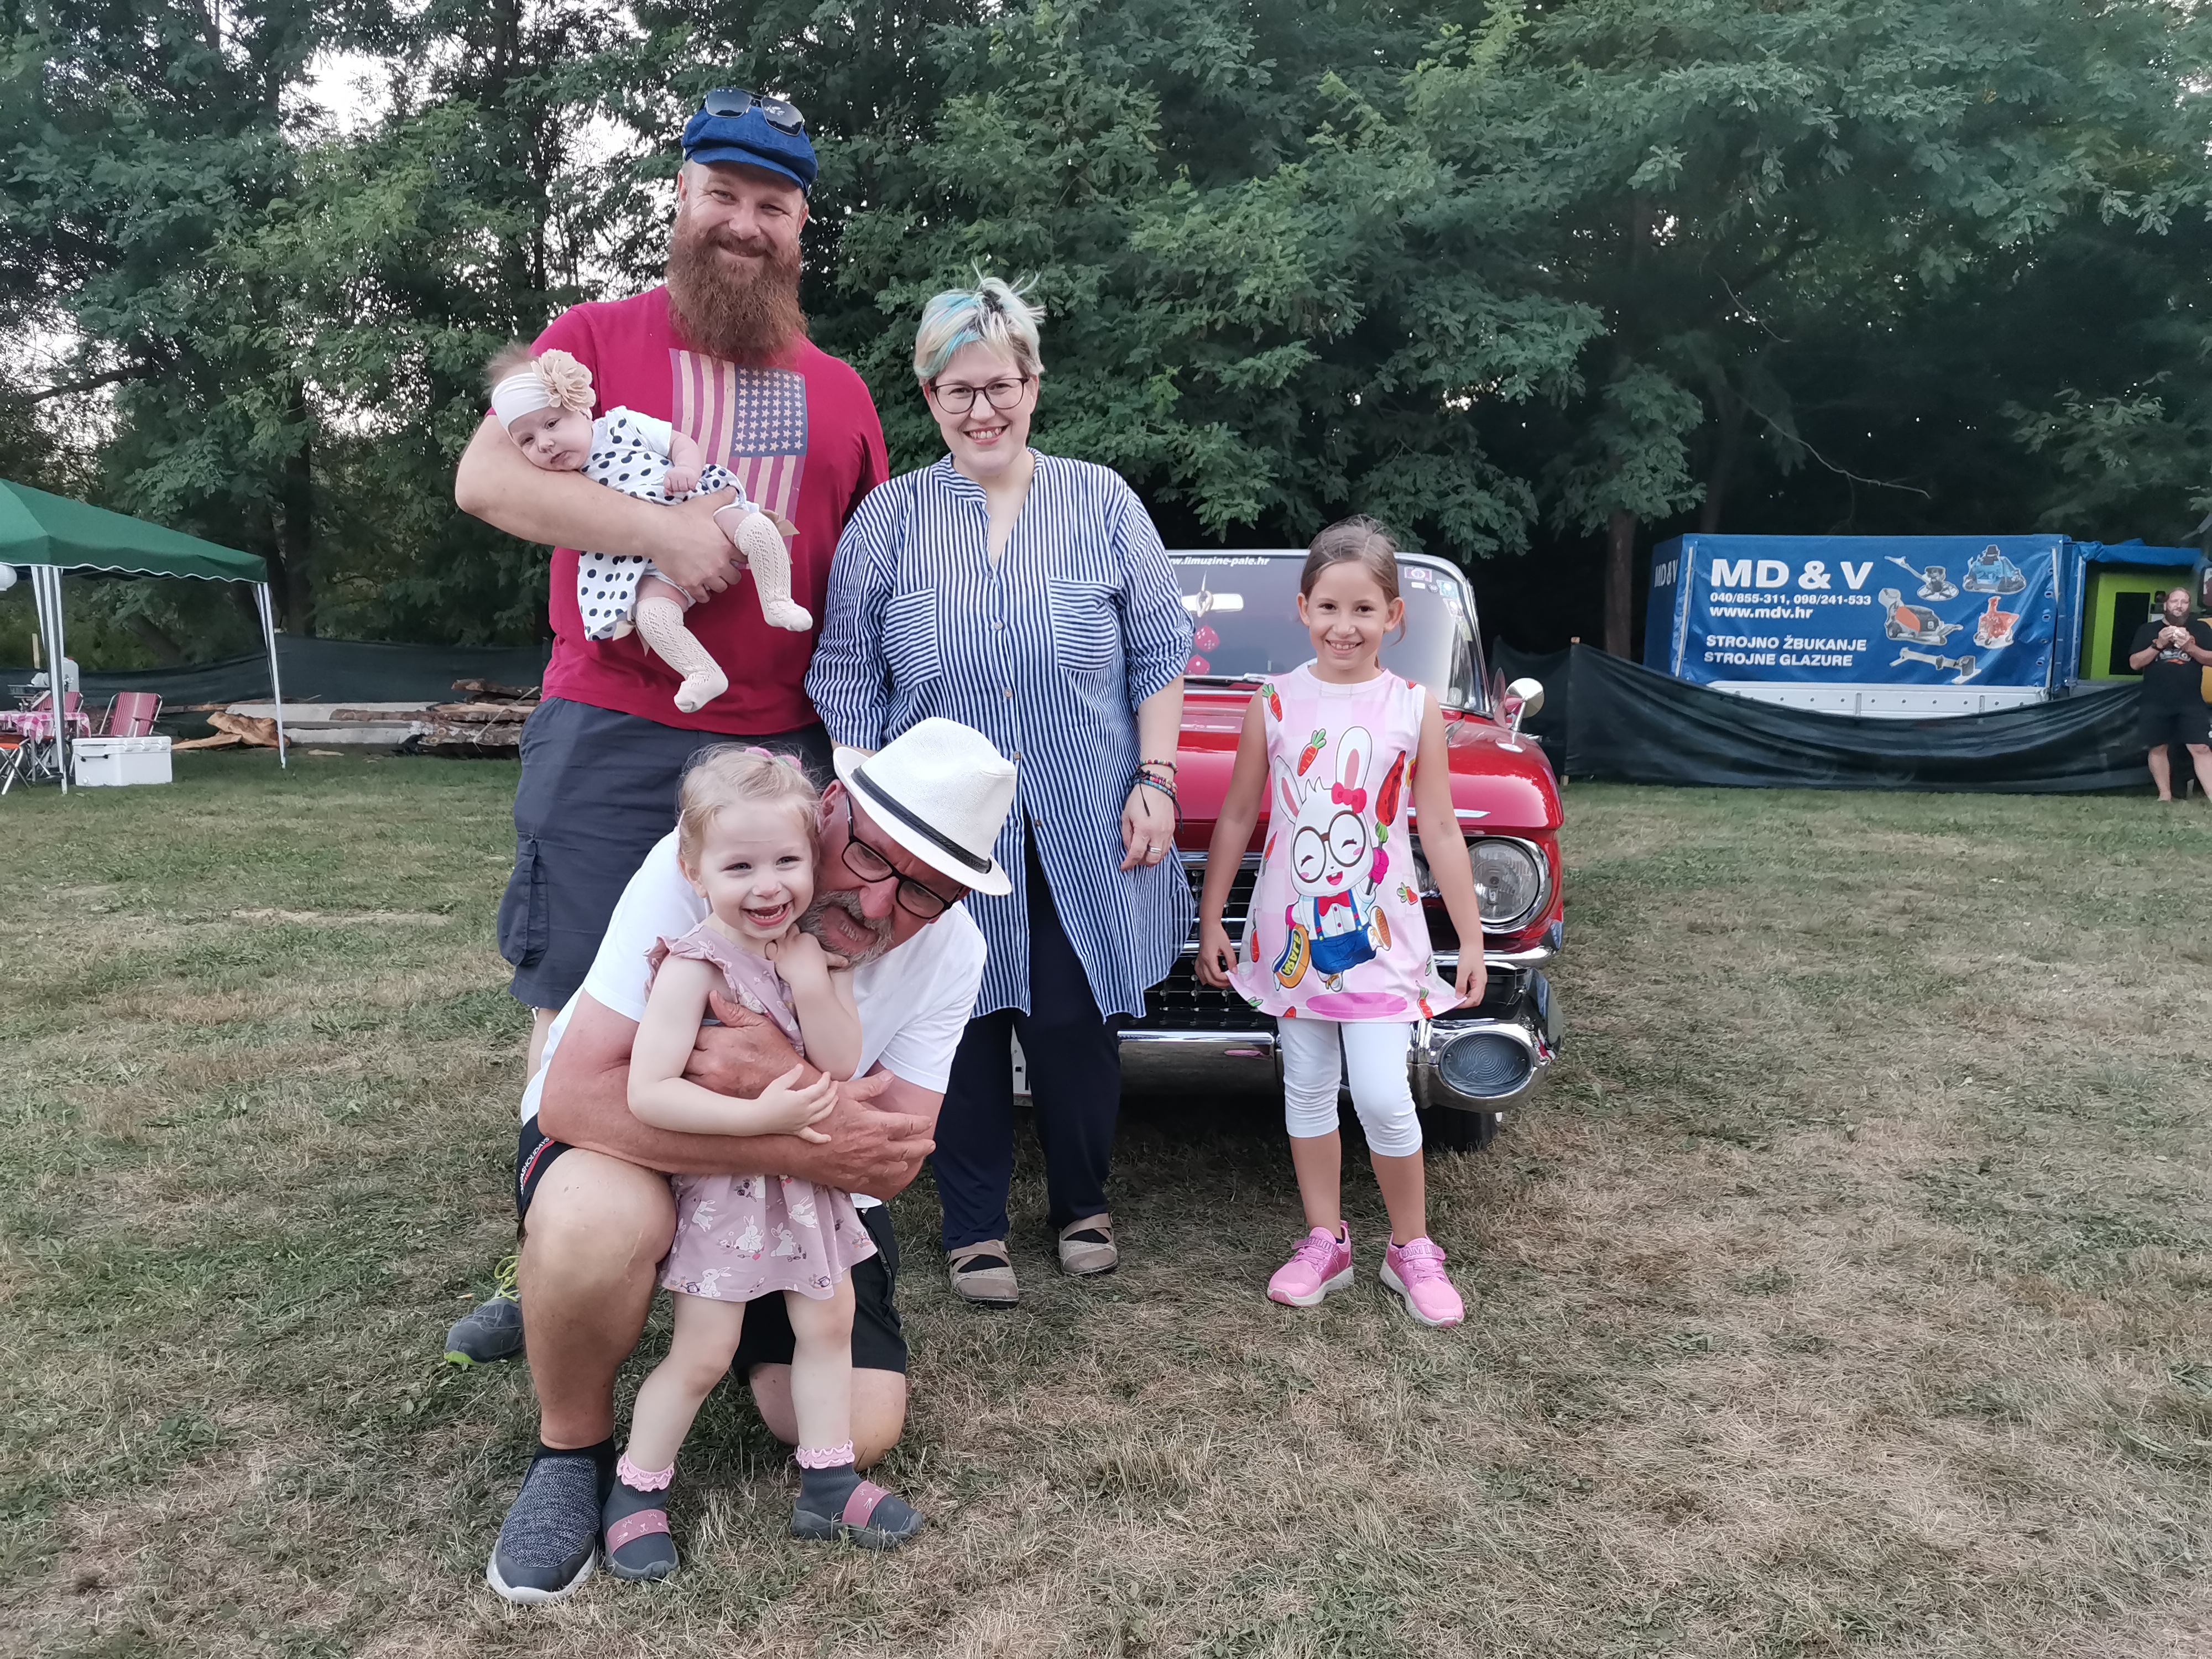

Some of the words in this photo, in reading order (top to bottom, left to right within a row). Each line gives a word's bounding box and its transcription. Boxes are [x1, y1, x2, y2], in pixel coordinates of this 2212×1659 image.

[1169, 556, 1270, 567] w.limuzine-pale.hr
[1711, 559, 1790, 588] MD
[1798, 560, 1831, 589] &
[1840, 561, 1874, 589] V
[1710, 592, 1790, 605] 040/855-311,
[1793, 594, 1871, 606] 098/241-533
[1709, 606, 1814, 619] www.mdv.hr
[1706, 635, 1780, 649] STROJNO
[1782, 634, 1867, 651] ŽBUKANJE
[1704, 651, 1776, 666] STROJNE
[1779, 654, 1853, 667] GLAZURE
